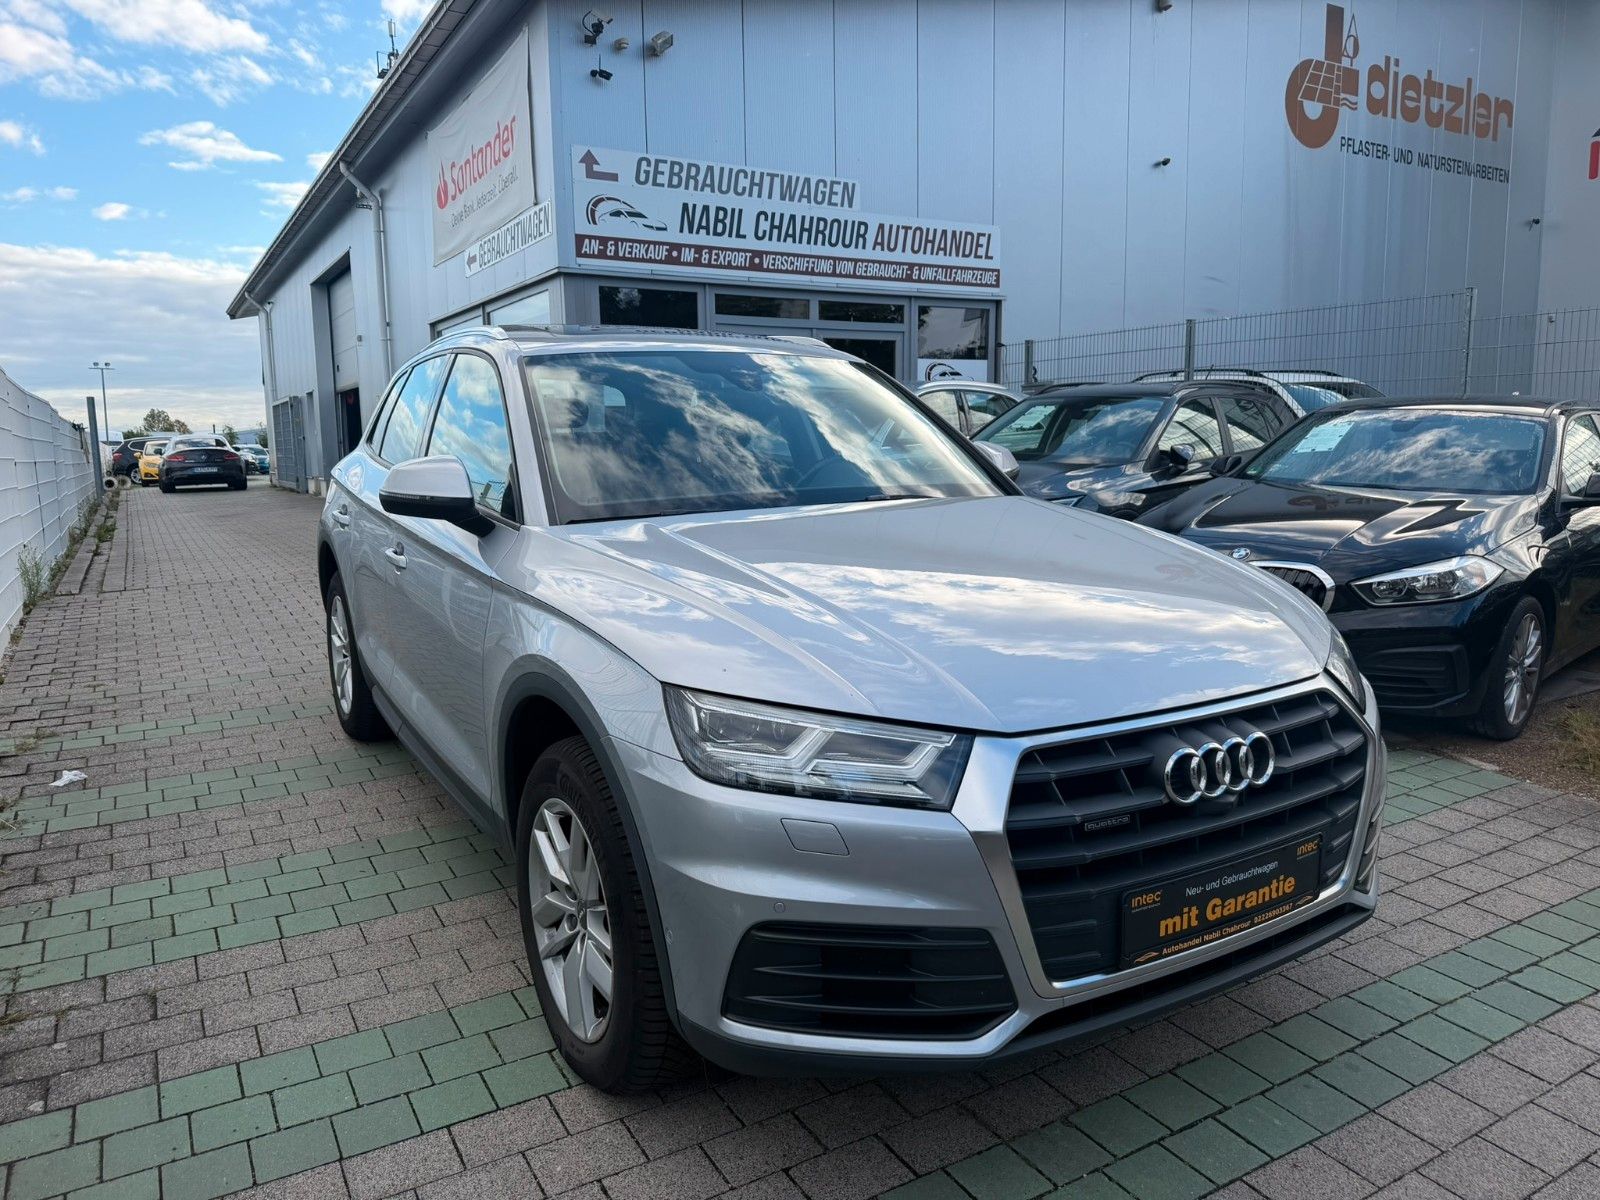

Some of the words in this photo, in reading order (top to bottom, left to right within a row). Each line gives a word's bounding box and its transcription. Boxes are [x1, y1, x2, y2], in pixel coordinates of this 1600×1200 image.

[1366, 55, 1514, 142] dietzler
[450, 115, 517, 201] Santander
[634, 156, 856, 209] GEBRAUCHTWAGEN
[1340, 136, 1391, 160] PFLASTER-
[1393, 145, 1413, 165] UND
[1417, 152, 1510, 184] NATURSTEINARBEITEN
[478, 201, 550, 269] GEBRAUCHTWAGEN
[679, 202, 747, 239] NABIL
[754, 210, 869, 250] CHAHROUR
[872, 223, 994, 260] AUTOHANDEL
[582, 238, 603, 254] AN-
[606, 241, 618, 256] &
[618, 241, 669, 261] VERKAUF
[680, 249, 698, 263] IM-
[701, 252, 711, 265] &
[711, 251, 752, 267] EXPORT
[763, 254, 833, 275] VERSCHIFFUNG
[835, 260, 854, 275] VON
[856, 262, 911, 279] GEBRAUCHT-
[912, 266, 919, 280] &
[920, 267, 998, 285] UNFALLFAHRZEUGE
[1159, 905, 1200, 937] mit
[1205, 874, 1296, 921] Garantie
[1186, 886, 1204, 896] Neu-
[1205, 879, 1220, 891] und
[1221, 861, 1279, 886] Gebrauchtwagen
[1162, 936, 1202, 955] Autohandel
[1203, 931, 1221, 942] Nabil
